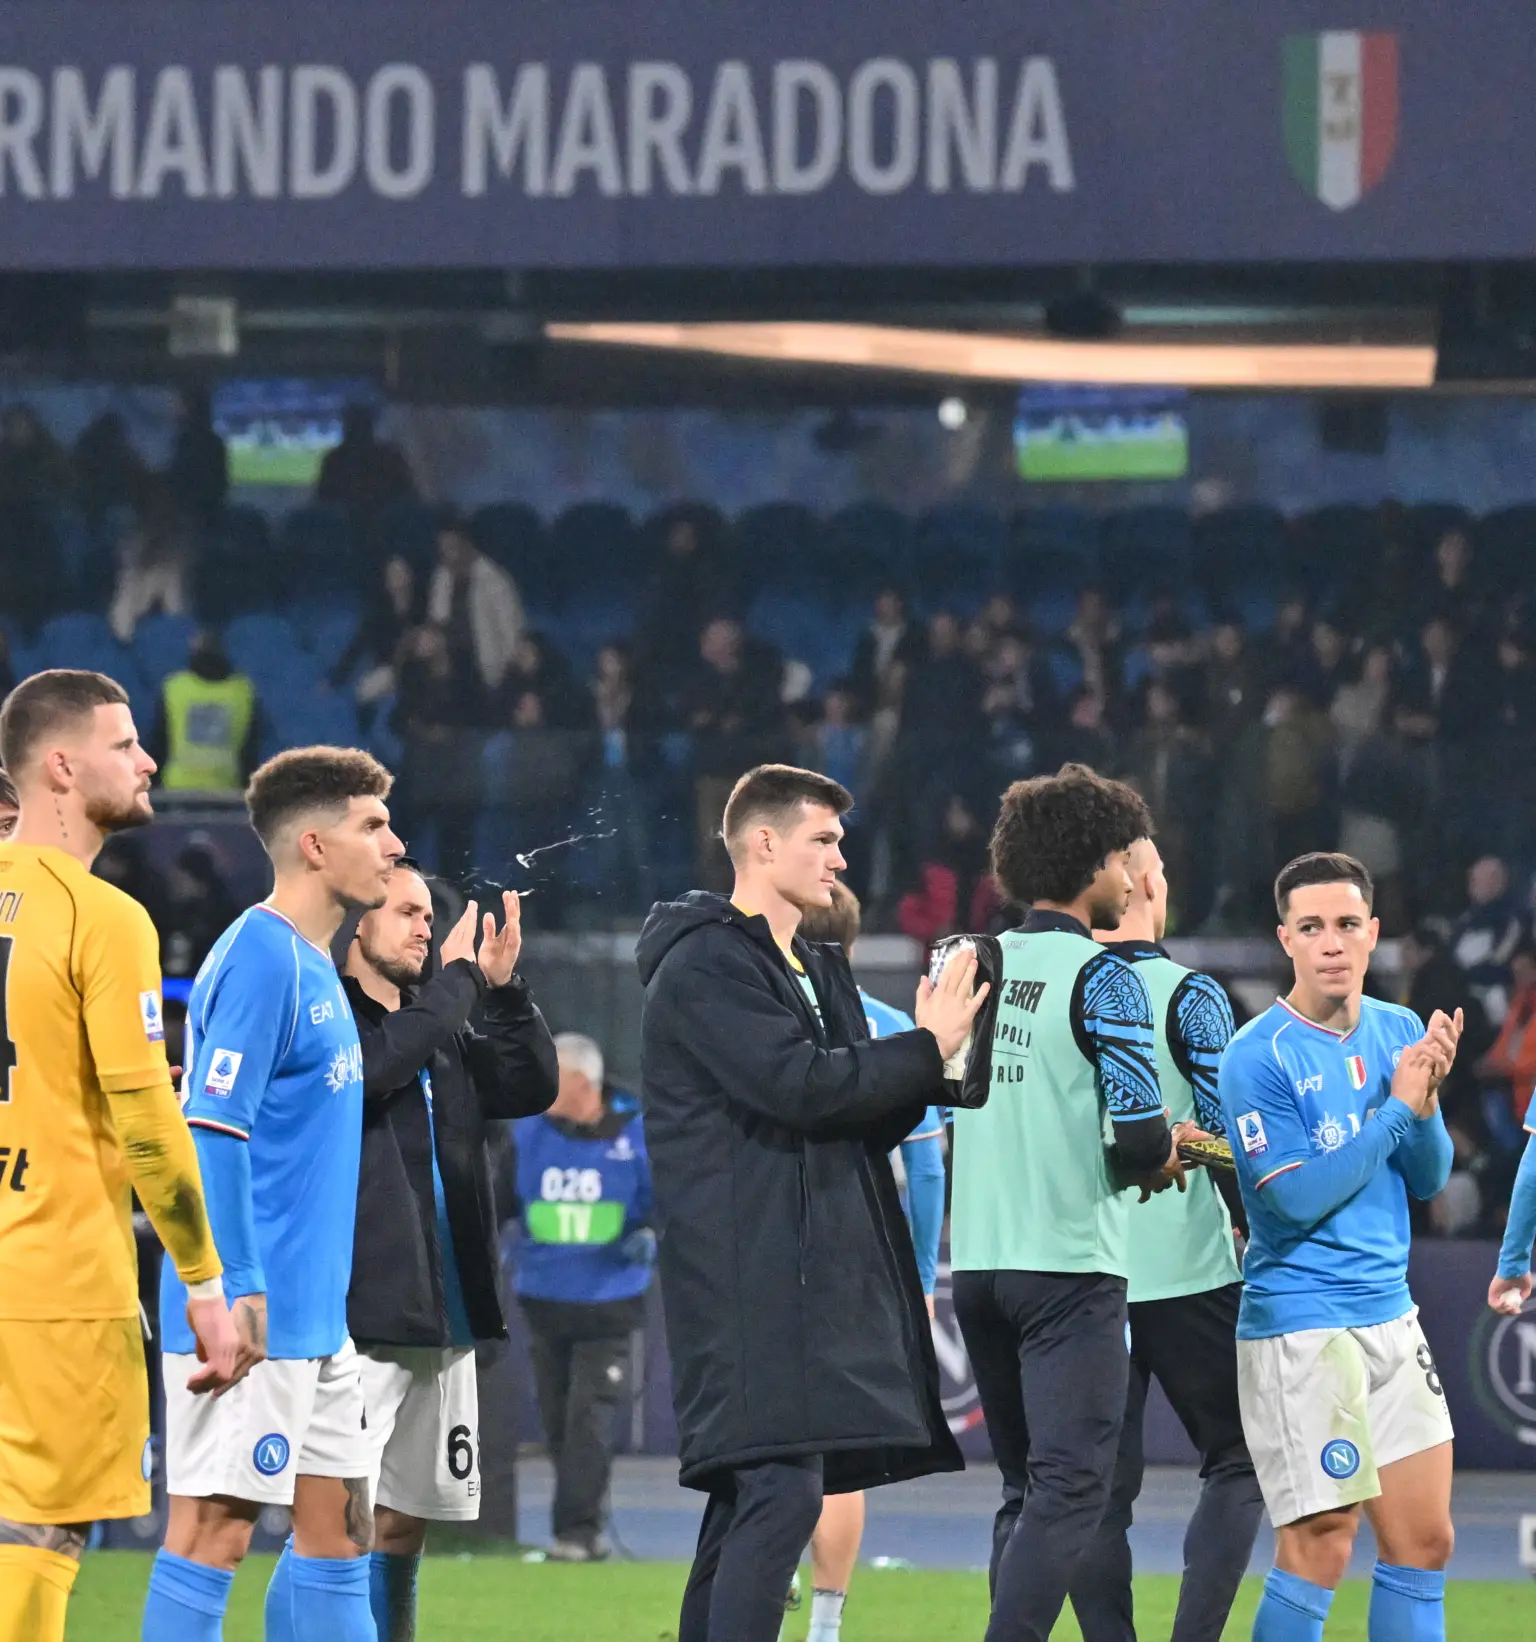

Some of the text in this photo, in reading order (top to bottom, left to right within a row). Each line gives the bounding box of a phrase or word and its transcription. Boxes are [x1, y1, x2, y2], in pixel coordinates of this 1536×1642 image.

[464, 55, 1077, 197] MARADONA
[995, 1021, 1031, 1048] POLI
[990, 1064, 1024, 1083] RLD
[1295, 1074, 1323, 1096] EA7
[541, 1165, 602, 1204] 026
[556, 1202, 593, 1242] TV
[262, 1443, 282, 1466] N
[448, 1424, 481, 1480] 6
[1330, 1448, 1350, 1470] N
